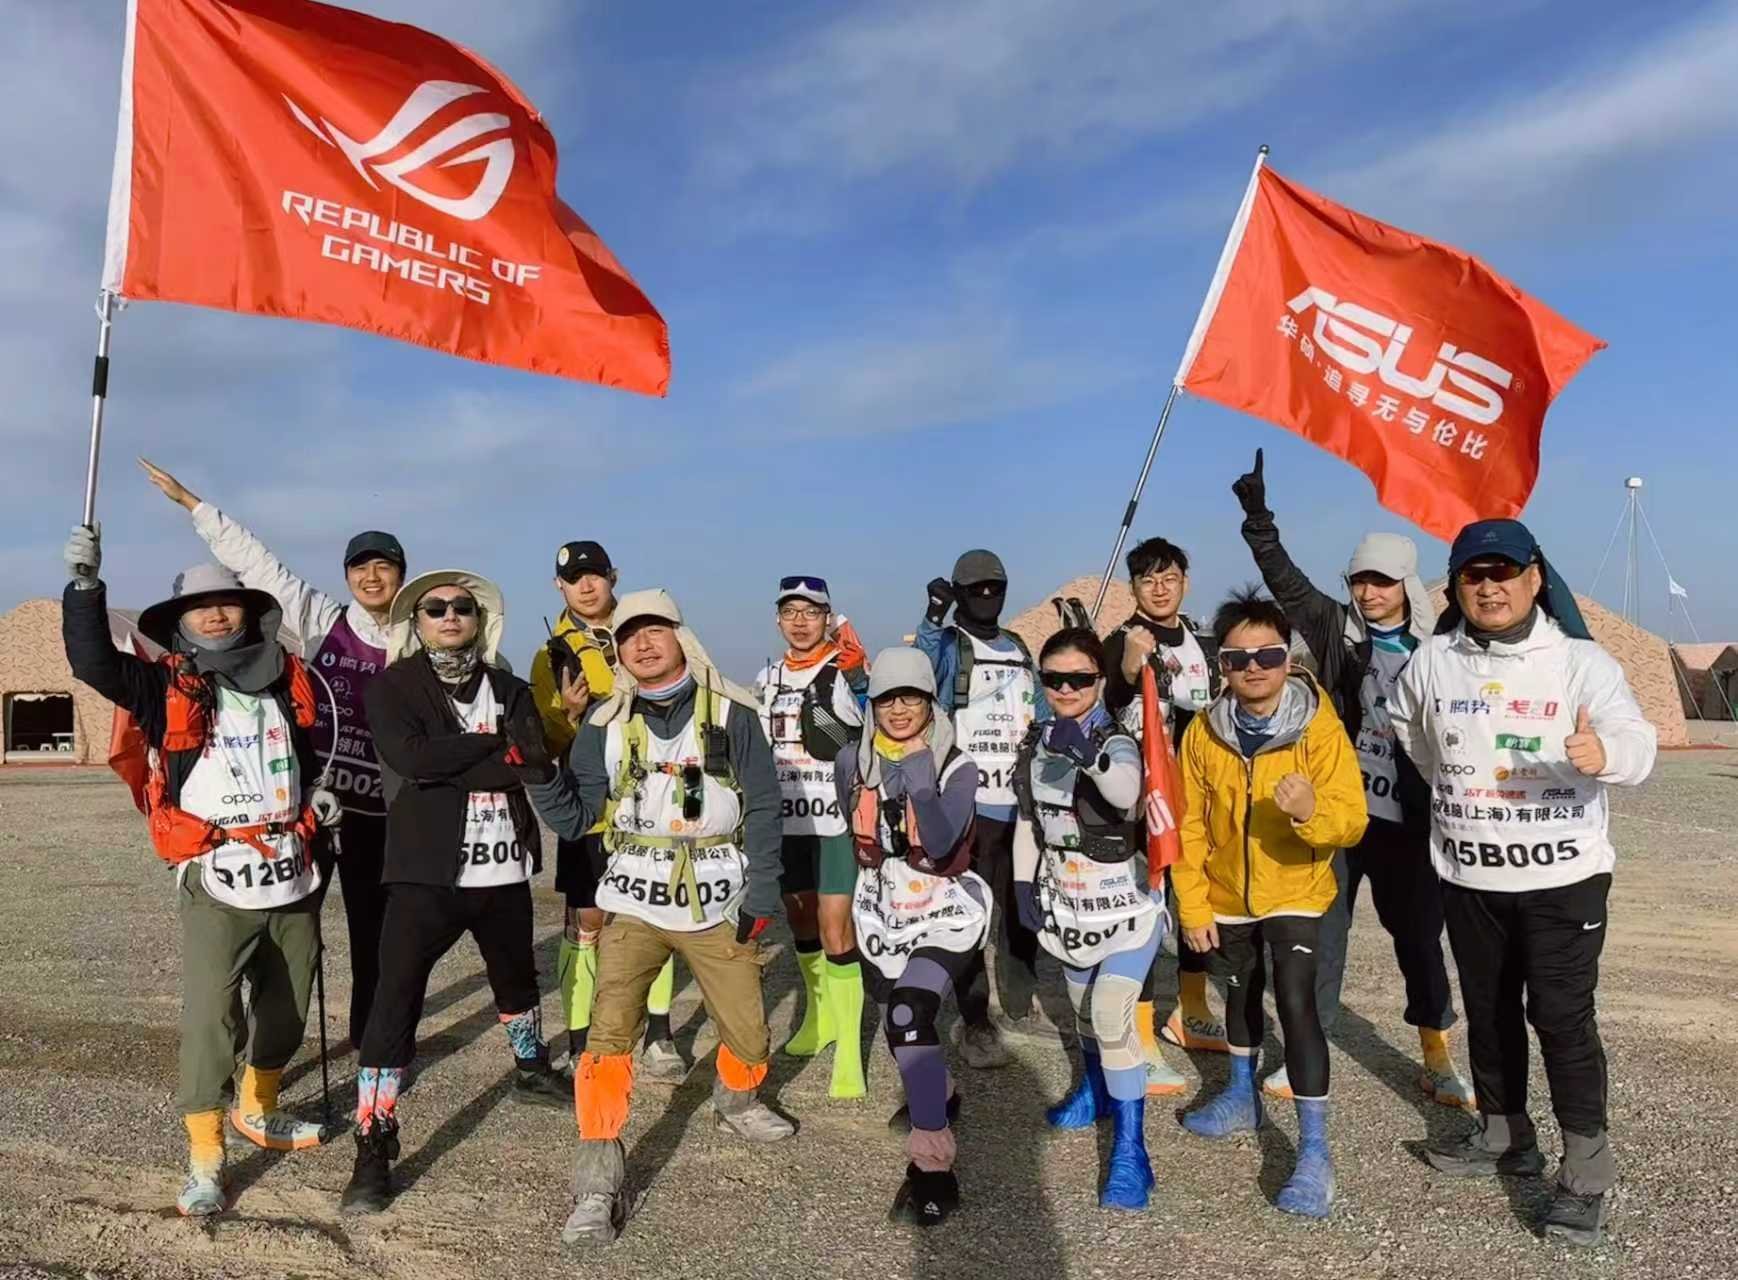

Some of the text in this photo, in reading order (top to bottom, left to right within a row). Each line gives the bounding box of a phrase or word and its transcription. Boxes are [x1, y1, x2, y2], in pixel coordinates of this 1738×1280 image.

[281, 189, 543, 287] REPUBLIC OF
[321, 234, 492, 305] GAMERS
[1286, 286, 1513, 425] ASUS
